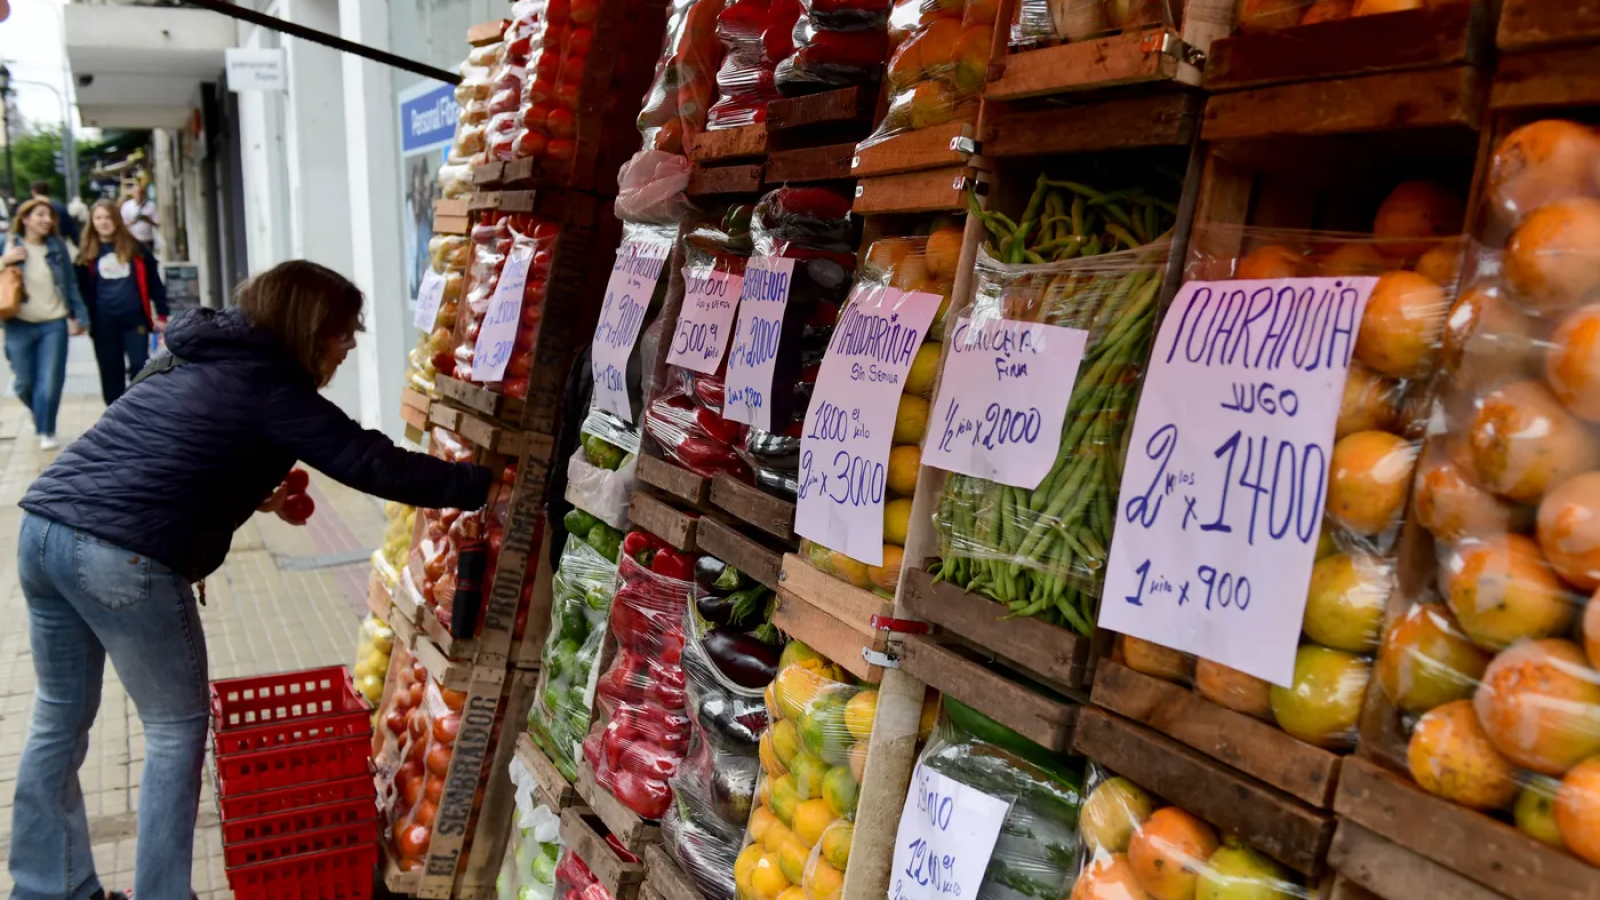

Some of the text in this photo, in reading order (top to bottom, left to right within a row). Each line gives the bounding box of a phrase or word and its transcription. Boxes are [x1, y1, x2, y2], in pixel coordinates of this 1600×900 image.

[746, 316, 780, 368] 2000
[953, 324, 1036, 354] CAUCHA
[1166, 281, 1360, 371] NARANJA
[807, 400, 848, 442] 1800
[1221, 382, 1299, 417] JUGO
[982, 402, 1041, 450] 2000
[829, 450, 884, 507] 3000
[1125, 423, 1178, 529] 2
[1200, 430, 1325, 545] 1400
[1125, 558, 1152, 606] 1
[1197, 565, 1252, 611] 900
[424, 849, 459, 878] EL
